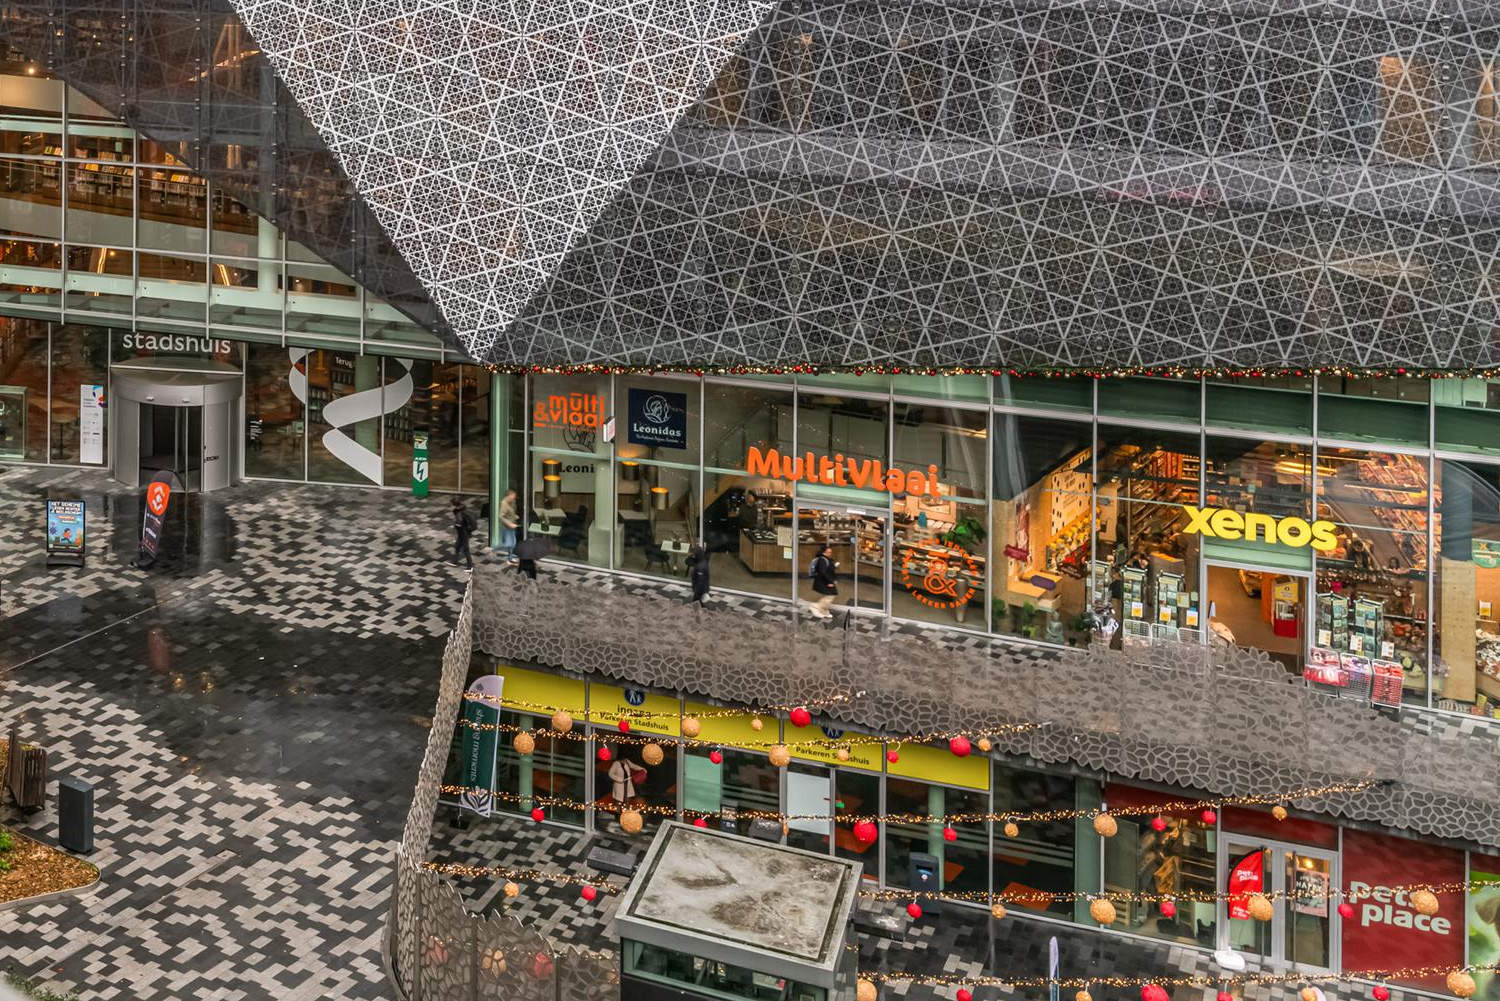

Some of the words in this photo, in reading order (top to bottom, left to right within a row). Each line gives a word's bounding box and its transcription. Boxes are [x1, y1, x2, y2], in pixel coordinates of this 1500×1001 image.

[122, 332, 231, 354] stadshuis
[633, 422, 682, 438] Leonidas
[747, 446, 941, 498] MultiVlaai
[1182, 505, 1338, 551] xenos
[634, 718, 669, 731] Stadshuis
[796, 746, 830, 759] Parkeren
[832, 752, 870, 765] Sshuis
[1360, 903, 1452, 935] place
